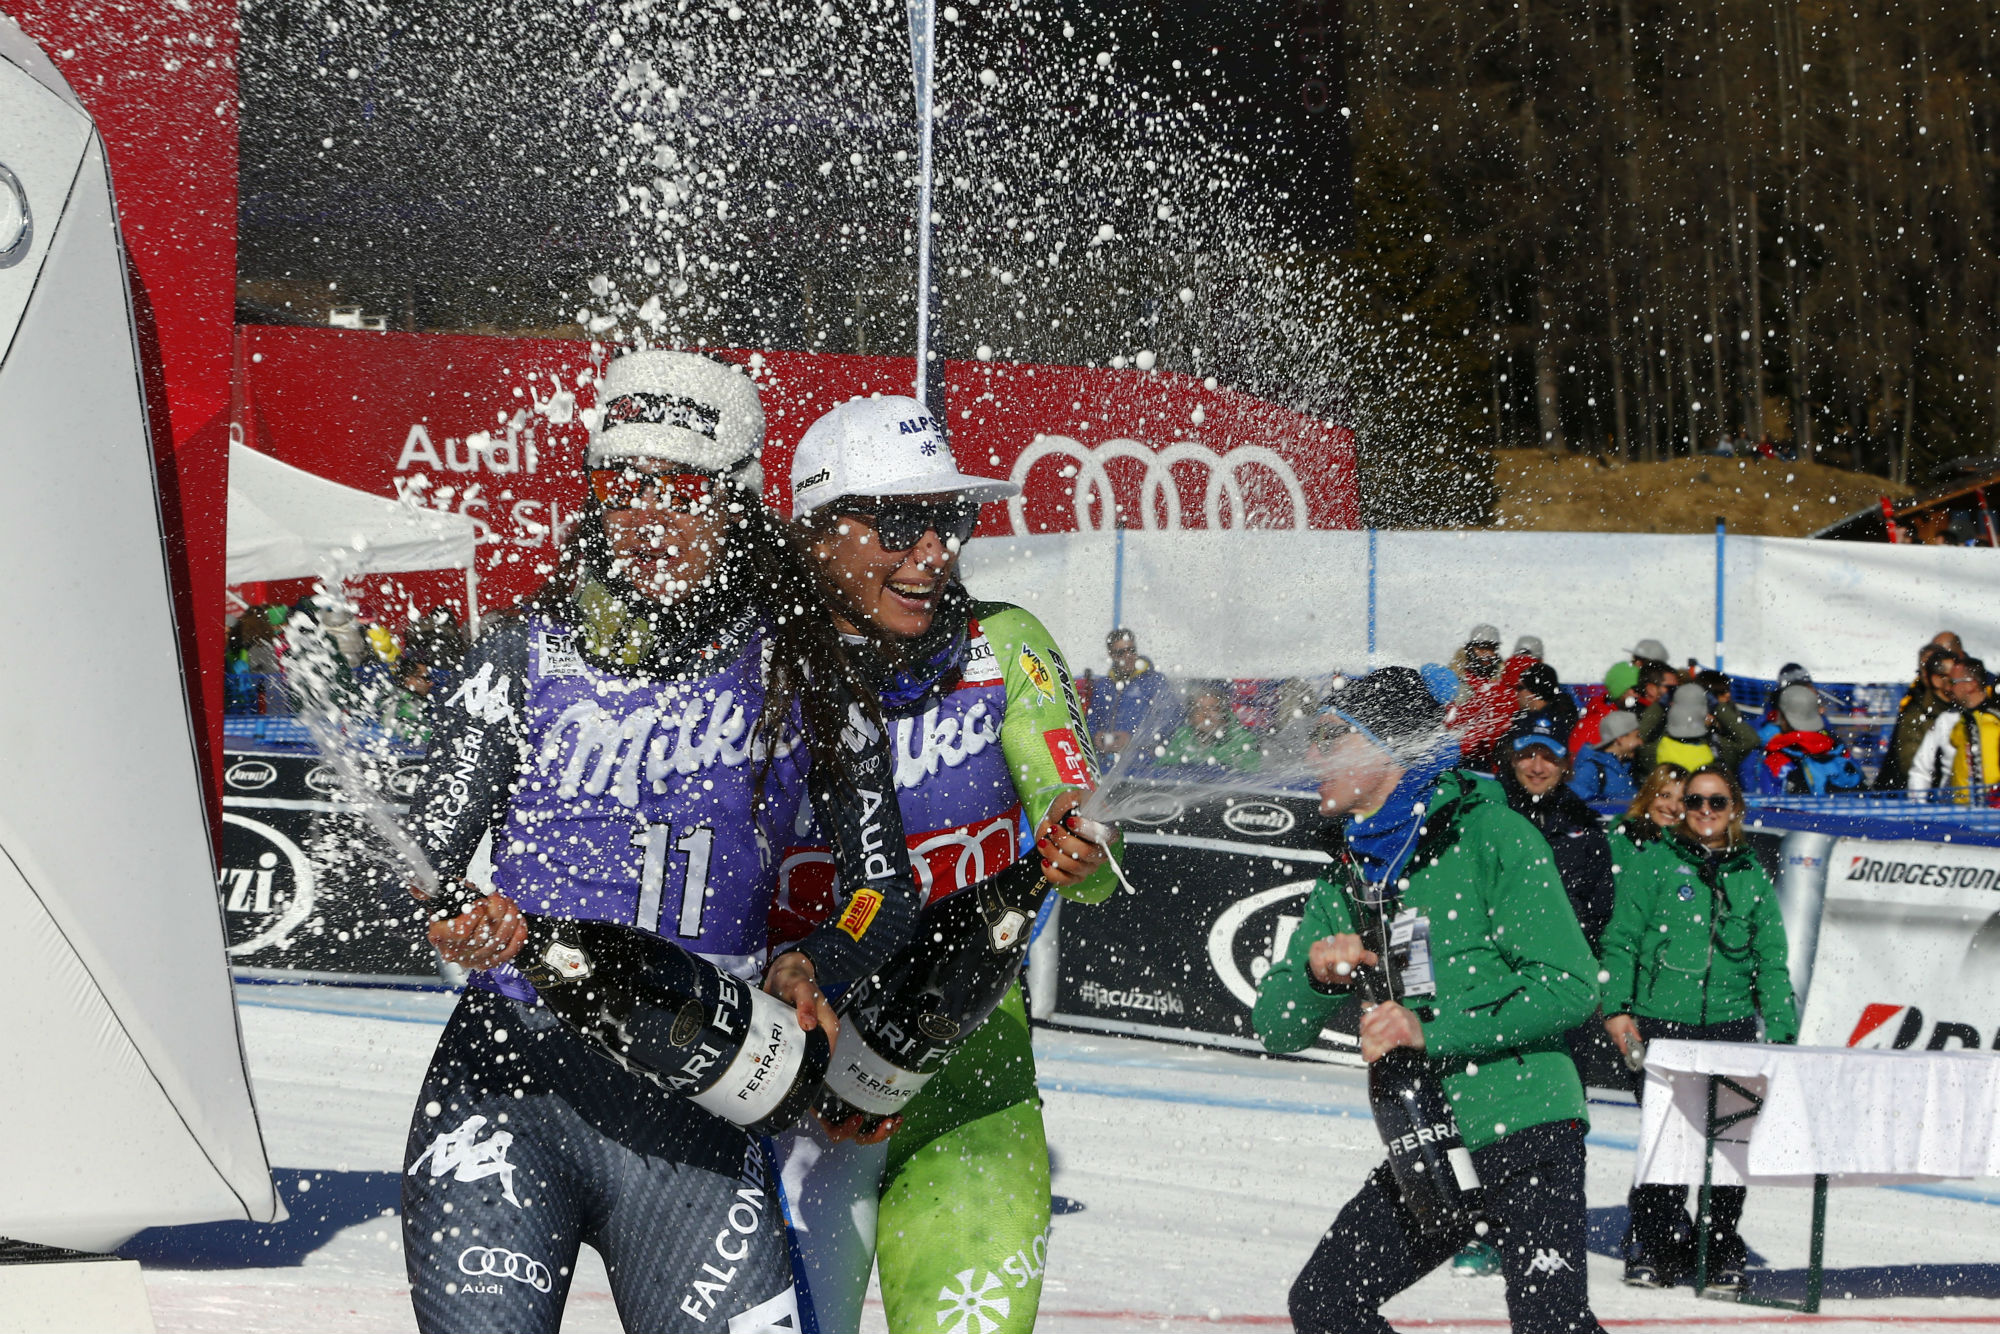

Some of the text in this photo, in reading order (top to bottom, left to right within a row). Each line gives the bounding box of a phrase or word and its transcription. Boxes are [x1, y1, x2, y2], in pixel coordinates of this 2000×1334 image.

[396, 424, 537, 474] Audi
[795, 468, 830, 495] eusch
[538, 690, 800, 808] Milka
[893, 703, 998, 792] lka
[856, 788, 897, 881] Aud
[220, 852, 278, 913] zi
[632, 822, 715, 938] 11
[1079, 980, 1184, 1014] #jacuzziski
[737, 1022, 784, 1101] FERRARI
[680, 1134, 766, 1323] FALCONERI
[460, 1283, 504, 1295] Audi
